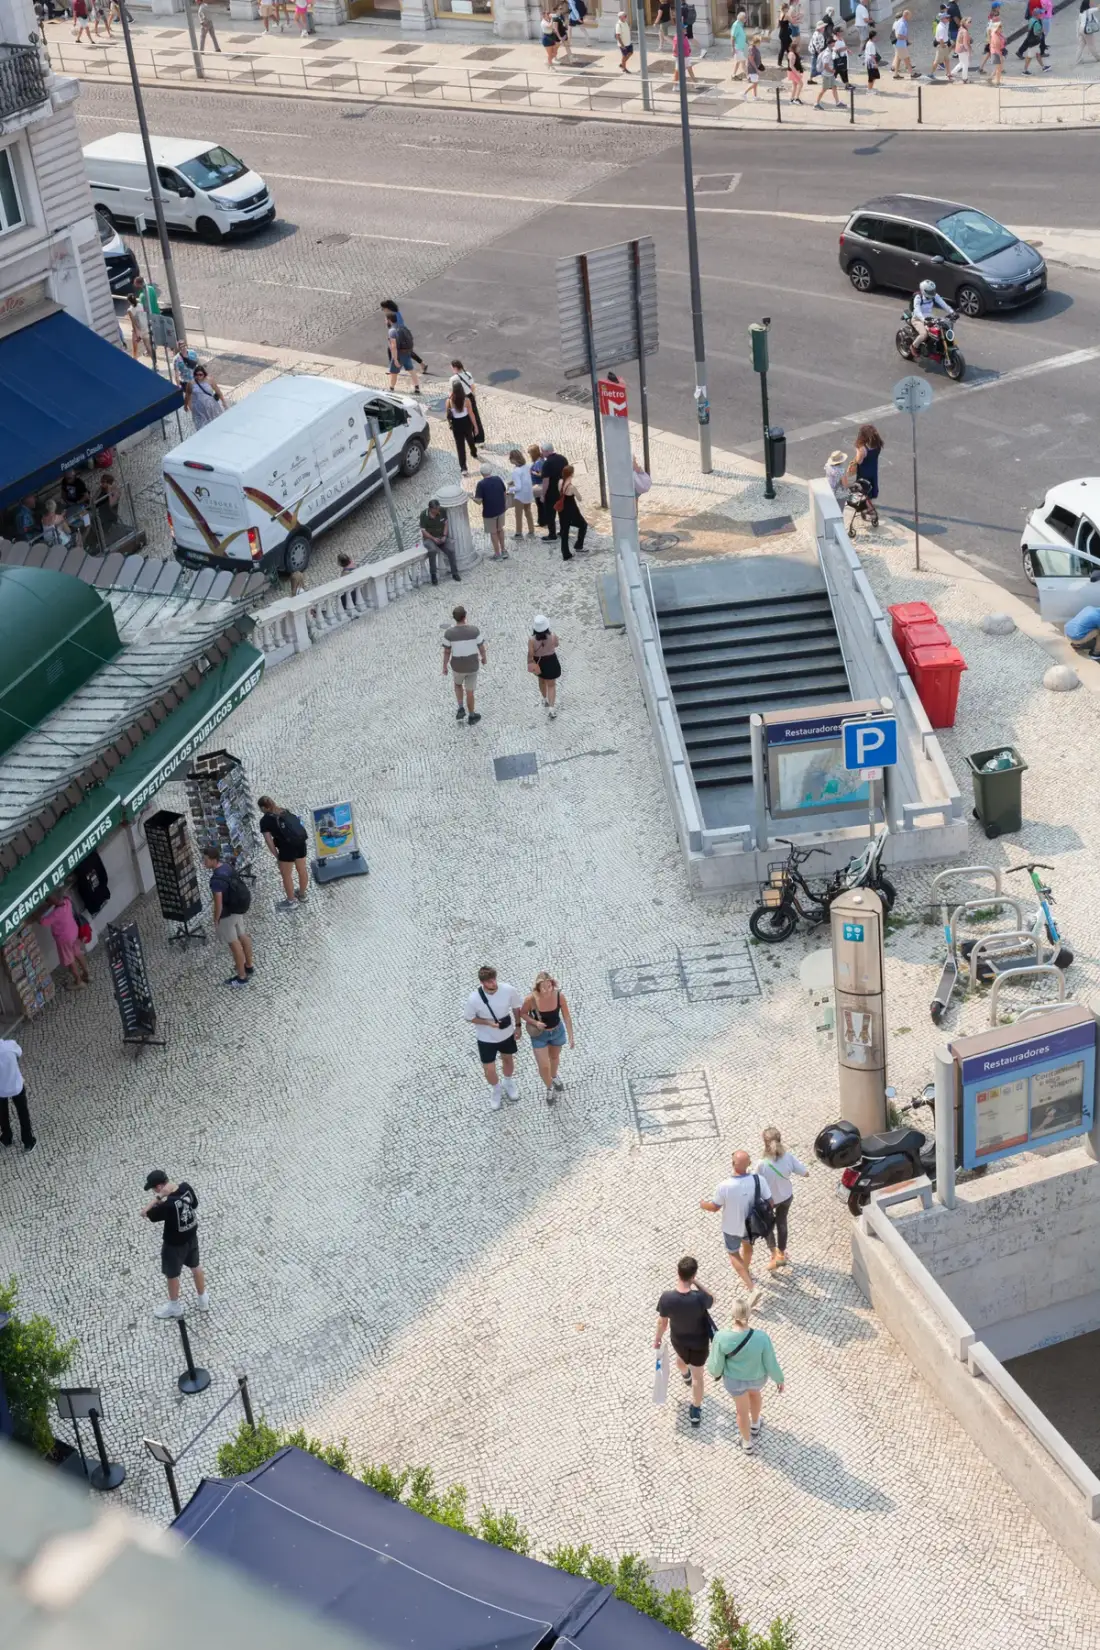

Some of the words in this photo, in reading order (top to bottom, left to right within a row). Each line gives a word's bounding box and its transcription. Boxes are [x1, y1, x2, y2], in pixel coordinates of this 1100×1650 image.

[785, 724, 842, 737] Restauradores
[856, 727, 885, 764] P
[131, 744, 192, 812] ESPETÁCULOS
[193, 700, 232, 748] PÚBLICOS
[5, 882, 50, 934] AGÊNCIA
[52, 864, 66, 886] DE
[67, 816, 112, 869] BILHETES
[983, 1045, 1050, 1071] Restauradores
